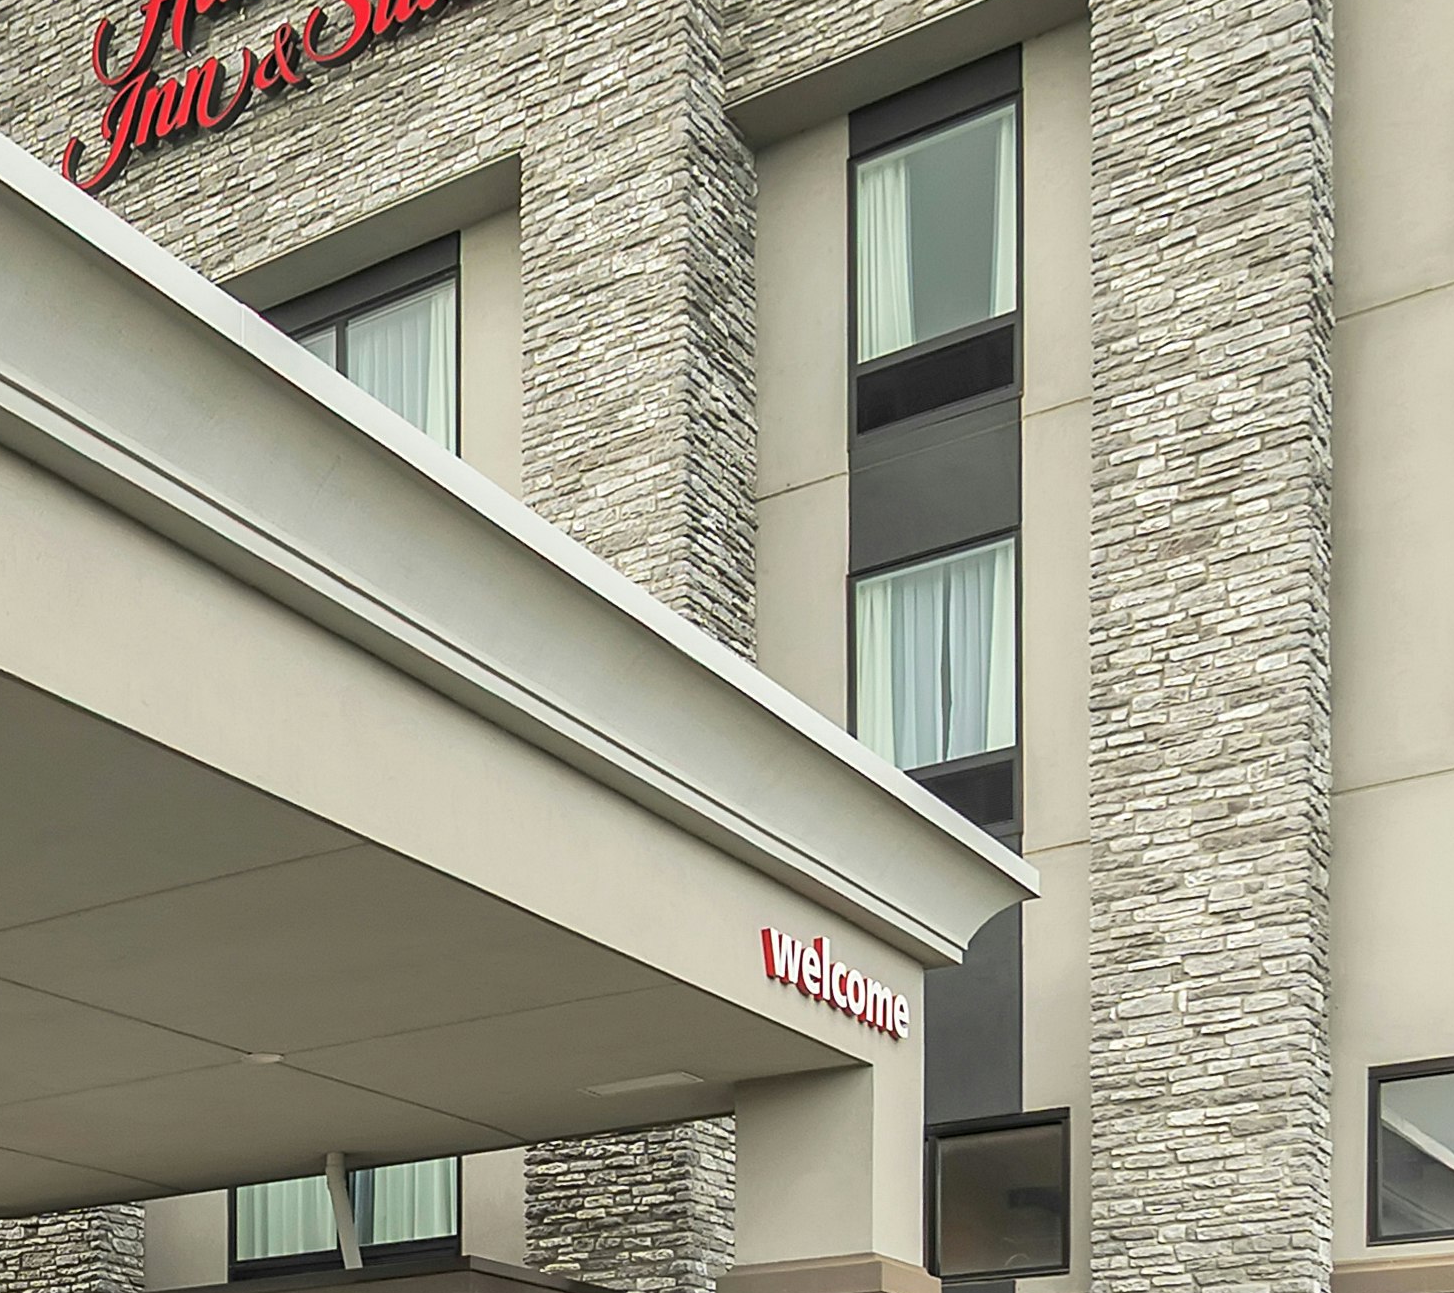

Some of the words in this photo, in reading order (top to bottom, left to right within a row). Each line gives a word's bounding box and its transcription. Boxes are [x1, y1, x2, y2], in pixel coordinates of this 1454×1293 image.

[61, 45, 258, 193] Inn
[254, 21, 308, 93] &
[760, 927, 910, 1041] welcome
